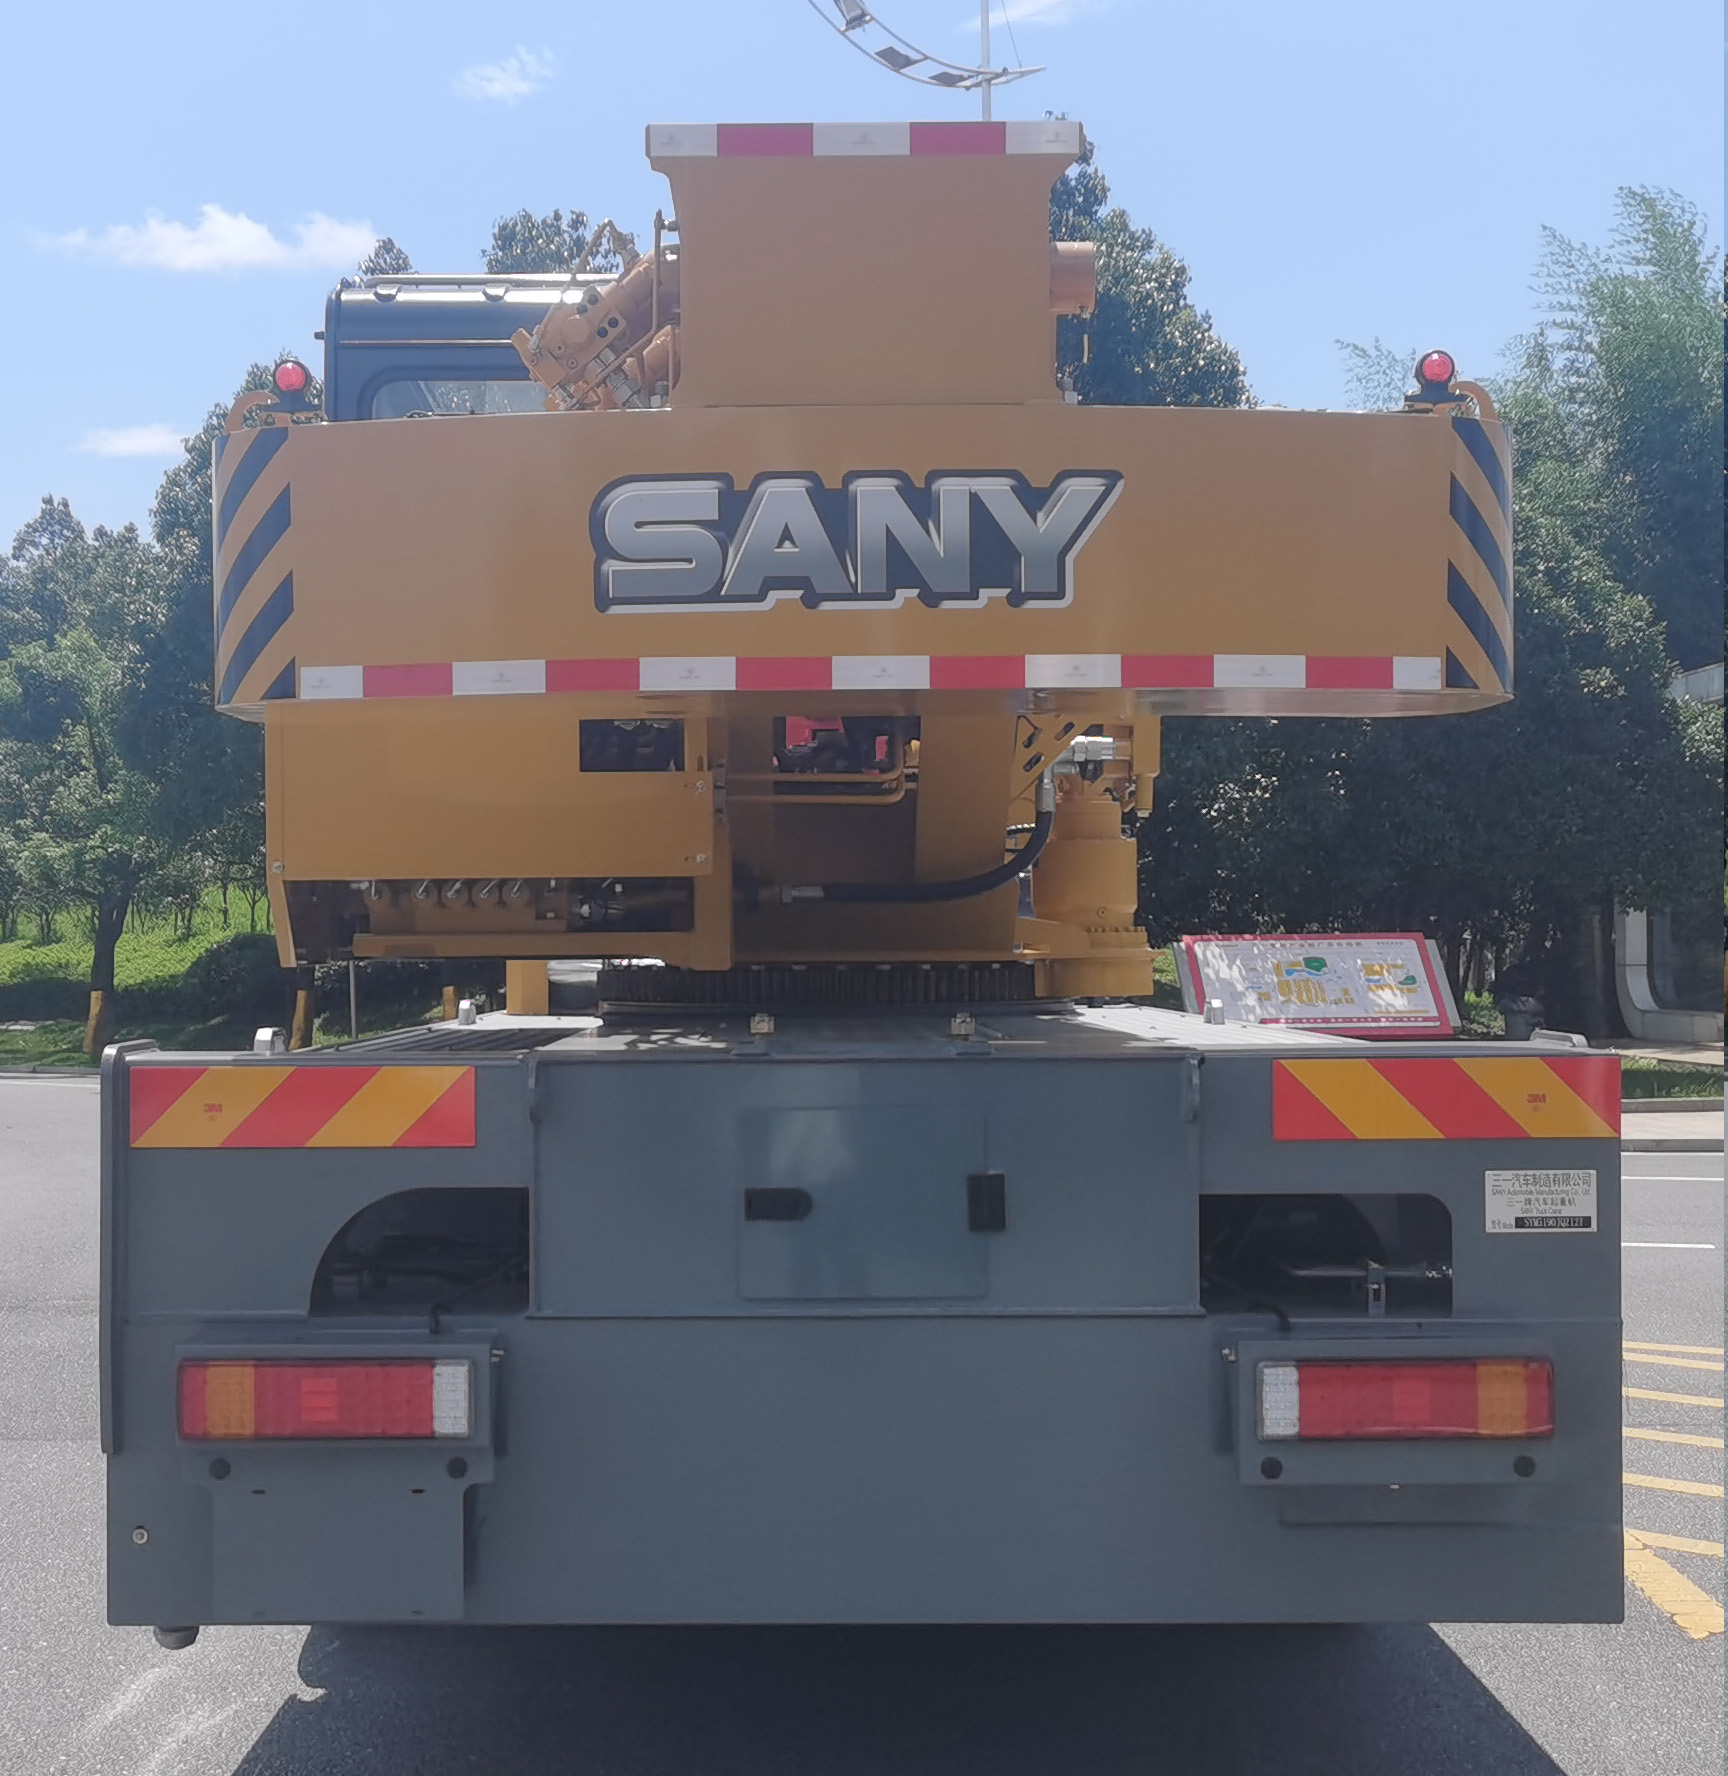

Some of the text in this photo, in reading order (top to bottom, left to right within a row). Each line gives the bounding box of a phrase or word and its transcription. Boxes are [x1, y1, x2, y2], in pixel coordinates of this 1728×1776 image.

[589, 470, 1125, 614] SANY
[1526, 1093, 1547, 1104] 3M
[1491, 1173, 1591, 1188] 三一汽车制造有限公司
